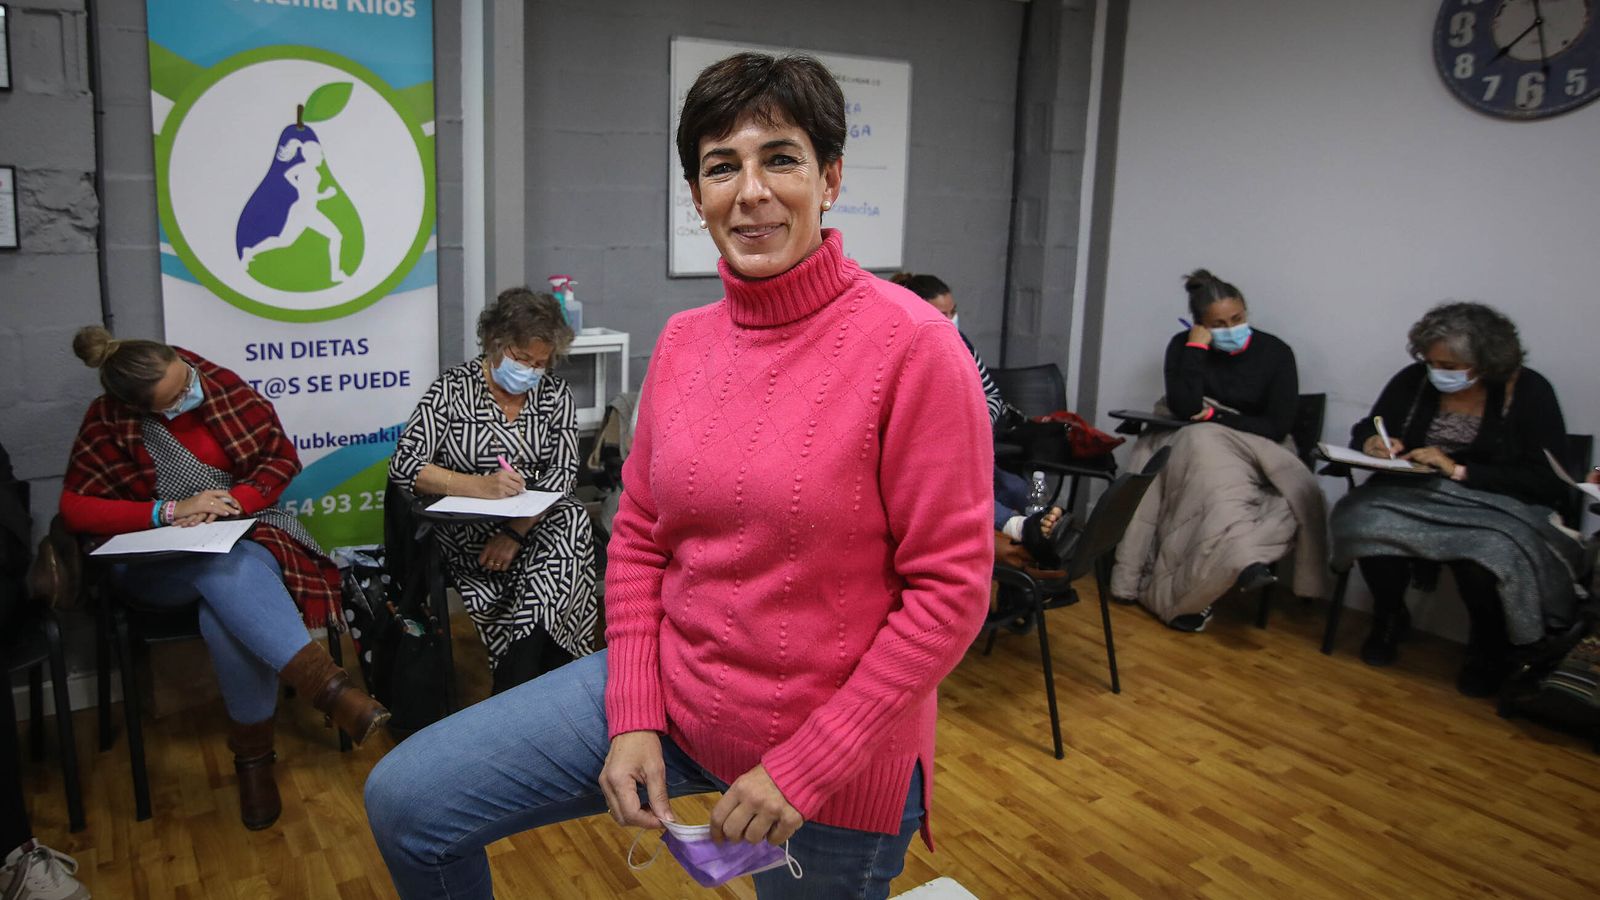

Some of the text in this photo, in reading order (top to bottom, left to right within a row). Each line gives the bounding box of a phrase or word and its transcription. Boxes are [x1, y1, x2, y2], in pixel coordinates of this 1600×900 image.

[347, 0, 416, 18] Kilos
[1448, 11, 1475, 48] 9
[1454, 53, 1475, 79] 8
[1482, 75, 1502, 101] 7
[1515, 71, 1545, 109] 6
[1564, 68, 1587, 97] 5
[245, 338, 370, 362] SIN DIETAS
[307, 375, 333, 393] SE
[339, 370, 411, 391] PUEDE
[321, 494, 352, 515] 93
